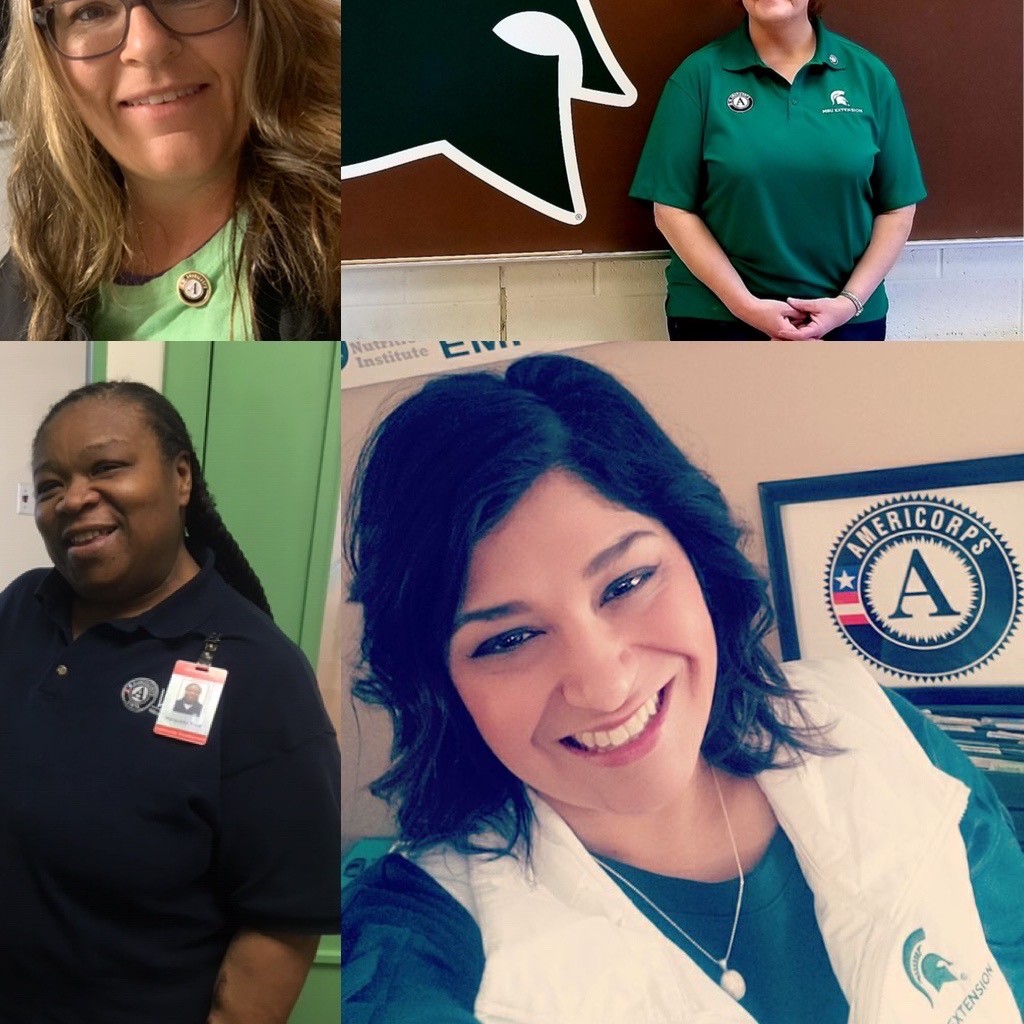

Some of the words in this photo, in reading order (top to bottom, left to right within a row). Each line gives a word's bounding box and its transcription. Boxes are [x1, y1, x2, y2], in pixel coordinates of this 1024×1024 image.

[356, 346, 429, 369] Institute
[846, 506, 992, 559] AMERICORPS
[887, 548, 961, 620] A
